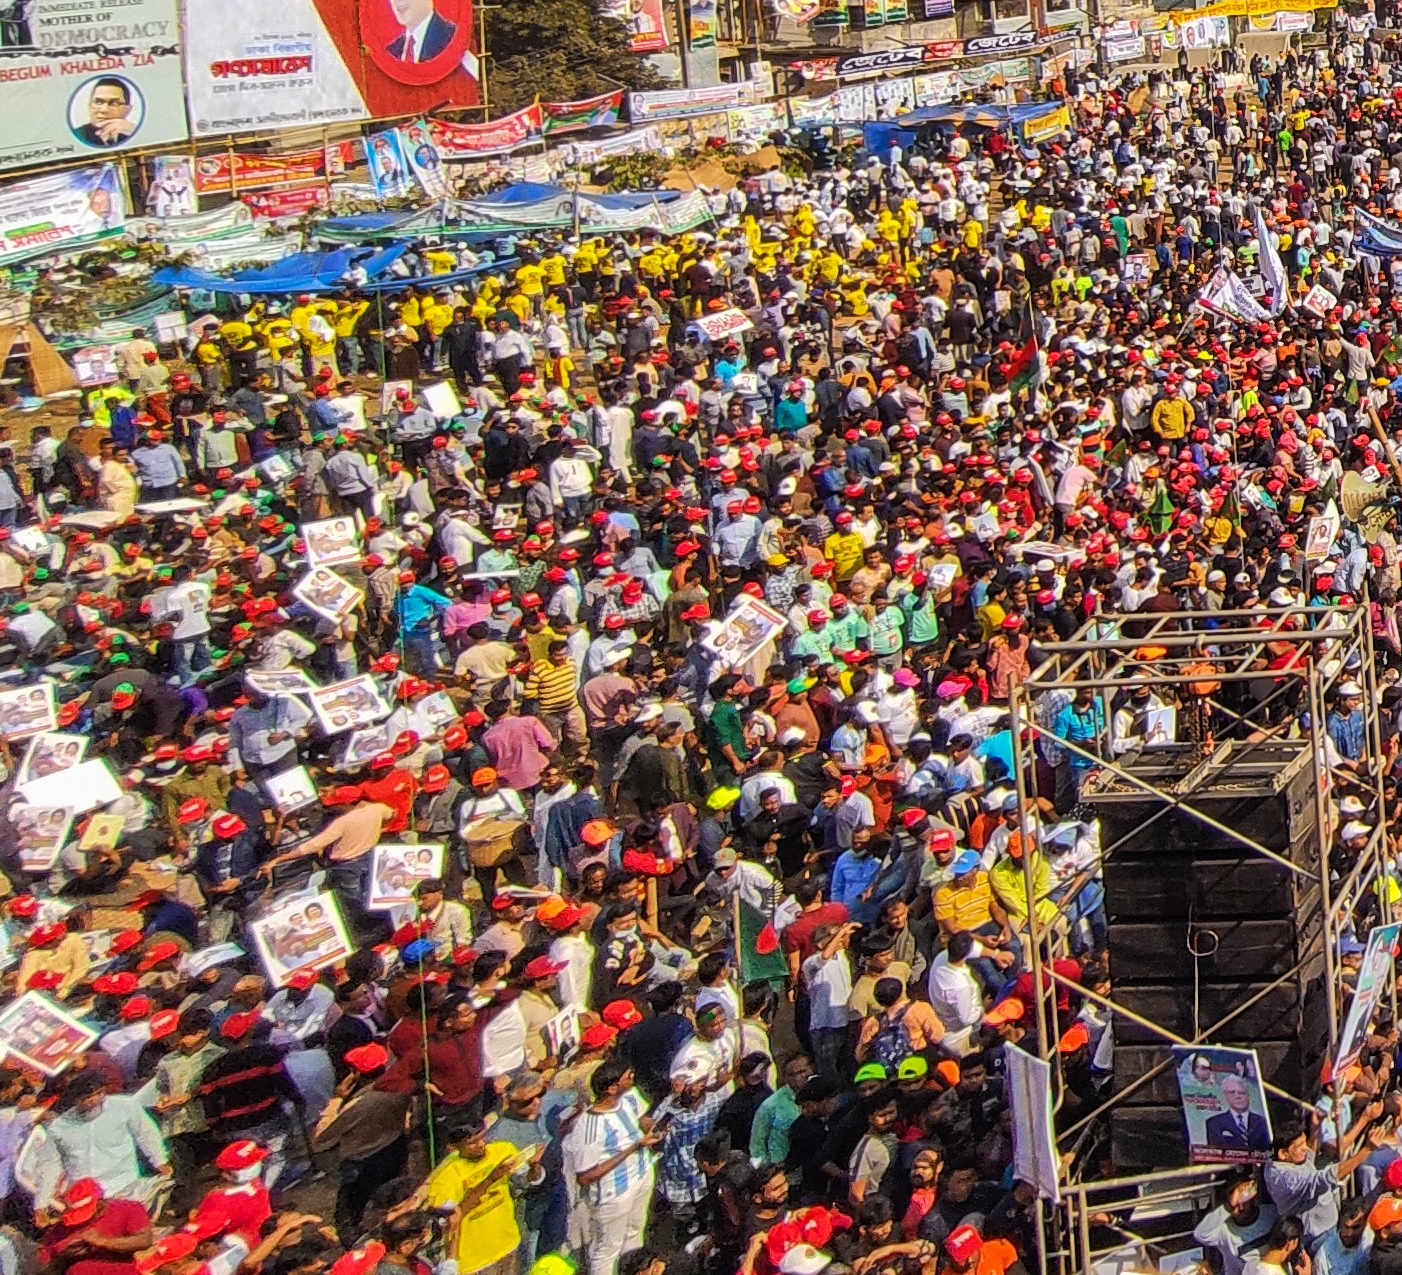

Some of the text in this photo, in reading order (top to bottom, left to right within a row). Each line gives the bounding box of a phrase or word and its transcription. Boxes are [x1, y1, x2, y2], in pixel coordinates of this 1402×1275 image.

[38, 12, 113, 27] MOTHER OF
[40, 20, 169, 47] DEMOCRACY
[0, 54, 155, 82] BEGUM KHALEDA ZIA
